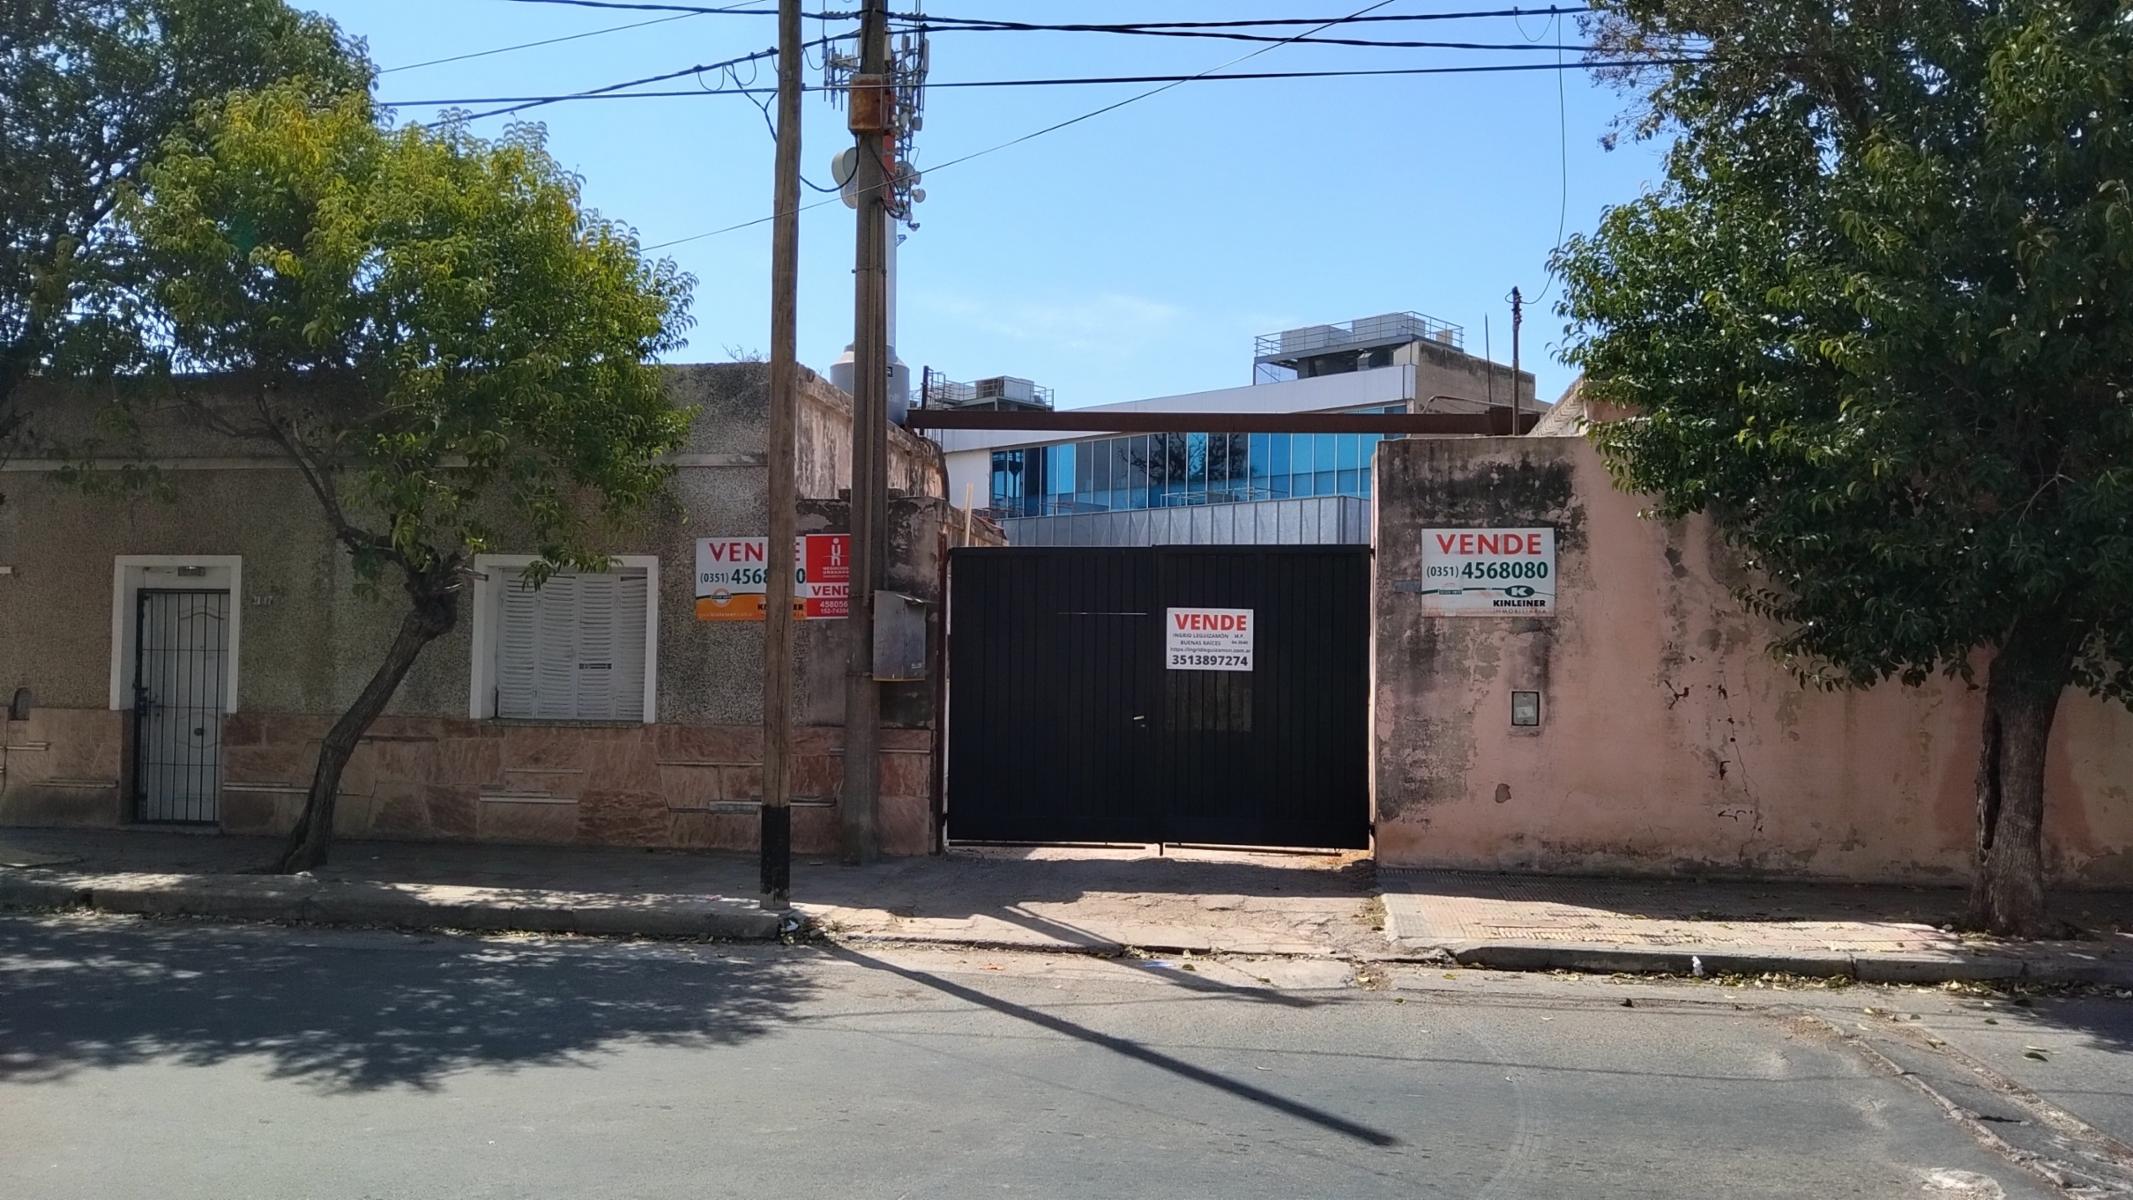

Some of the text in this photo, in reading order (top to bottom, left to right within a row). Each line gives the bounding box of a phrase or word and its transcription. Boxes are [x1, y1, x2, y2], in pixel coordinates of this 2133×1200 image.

[709, 542, 801, 562] VEN
[1436, 534, 1542, 555] VENDE
[700, 568, 806, 584] (0351) 4560
[1427, 561, 1548, 579] (0351) 4568080
[812, 586, 849, 596] VEND
[1174, 614, 1247, 631] VENDE
[1172, 654, 1248, 666] 3513897274
